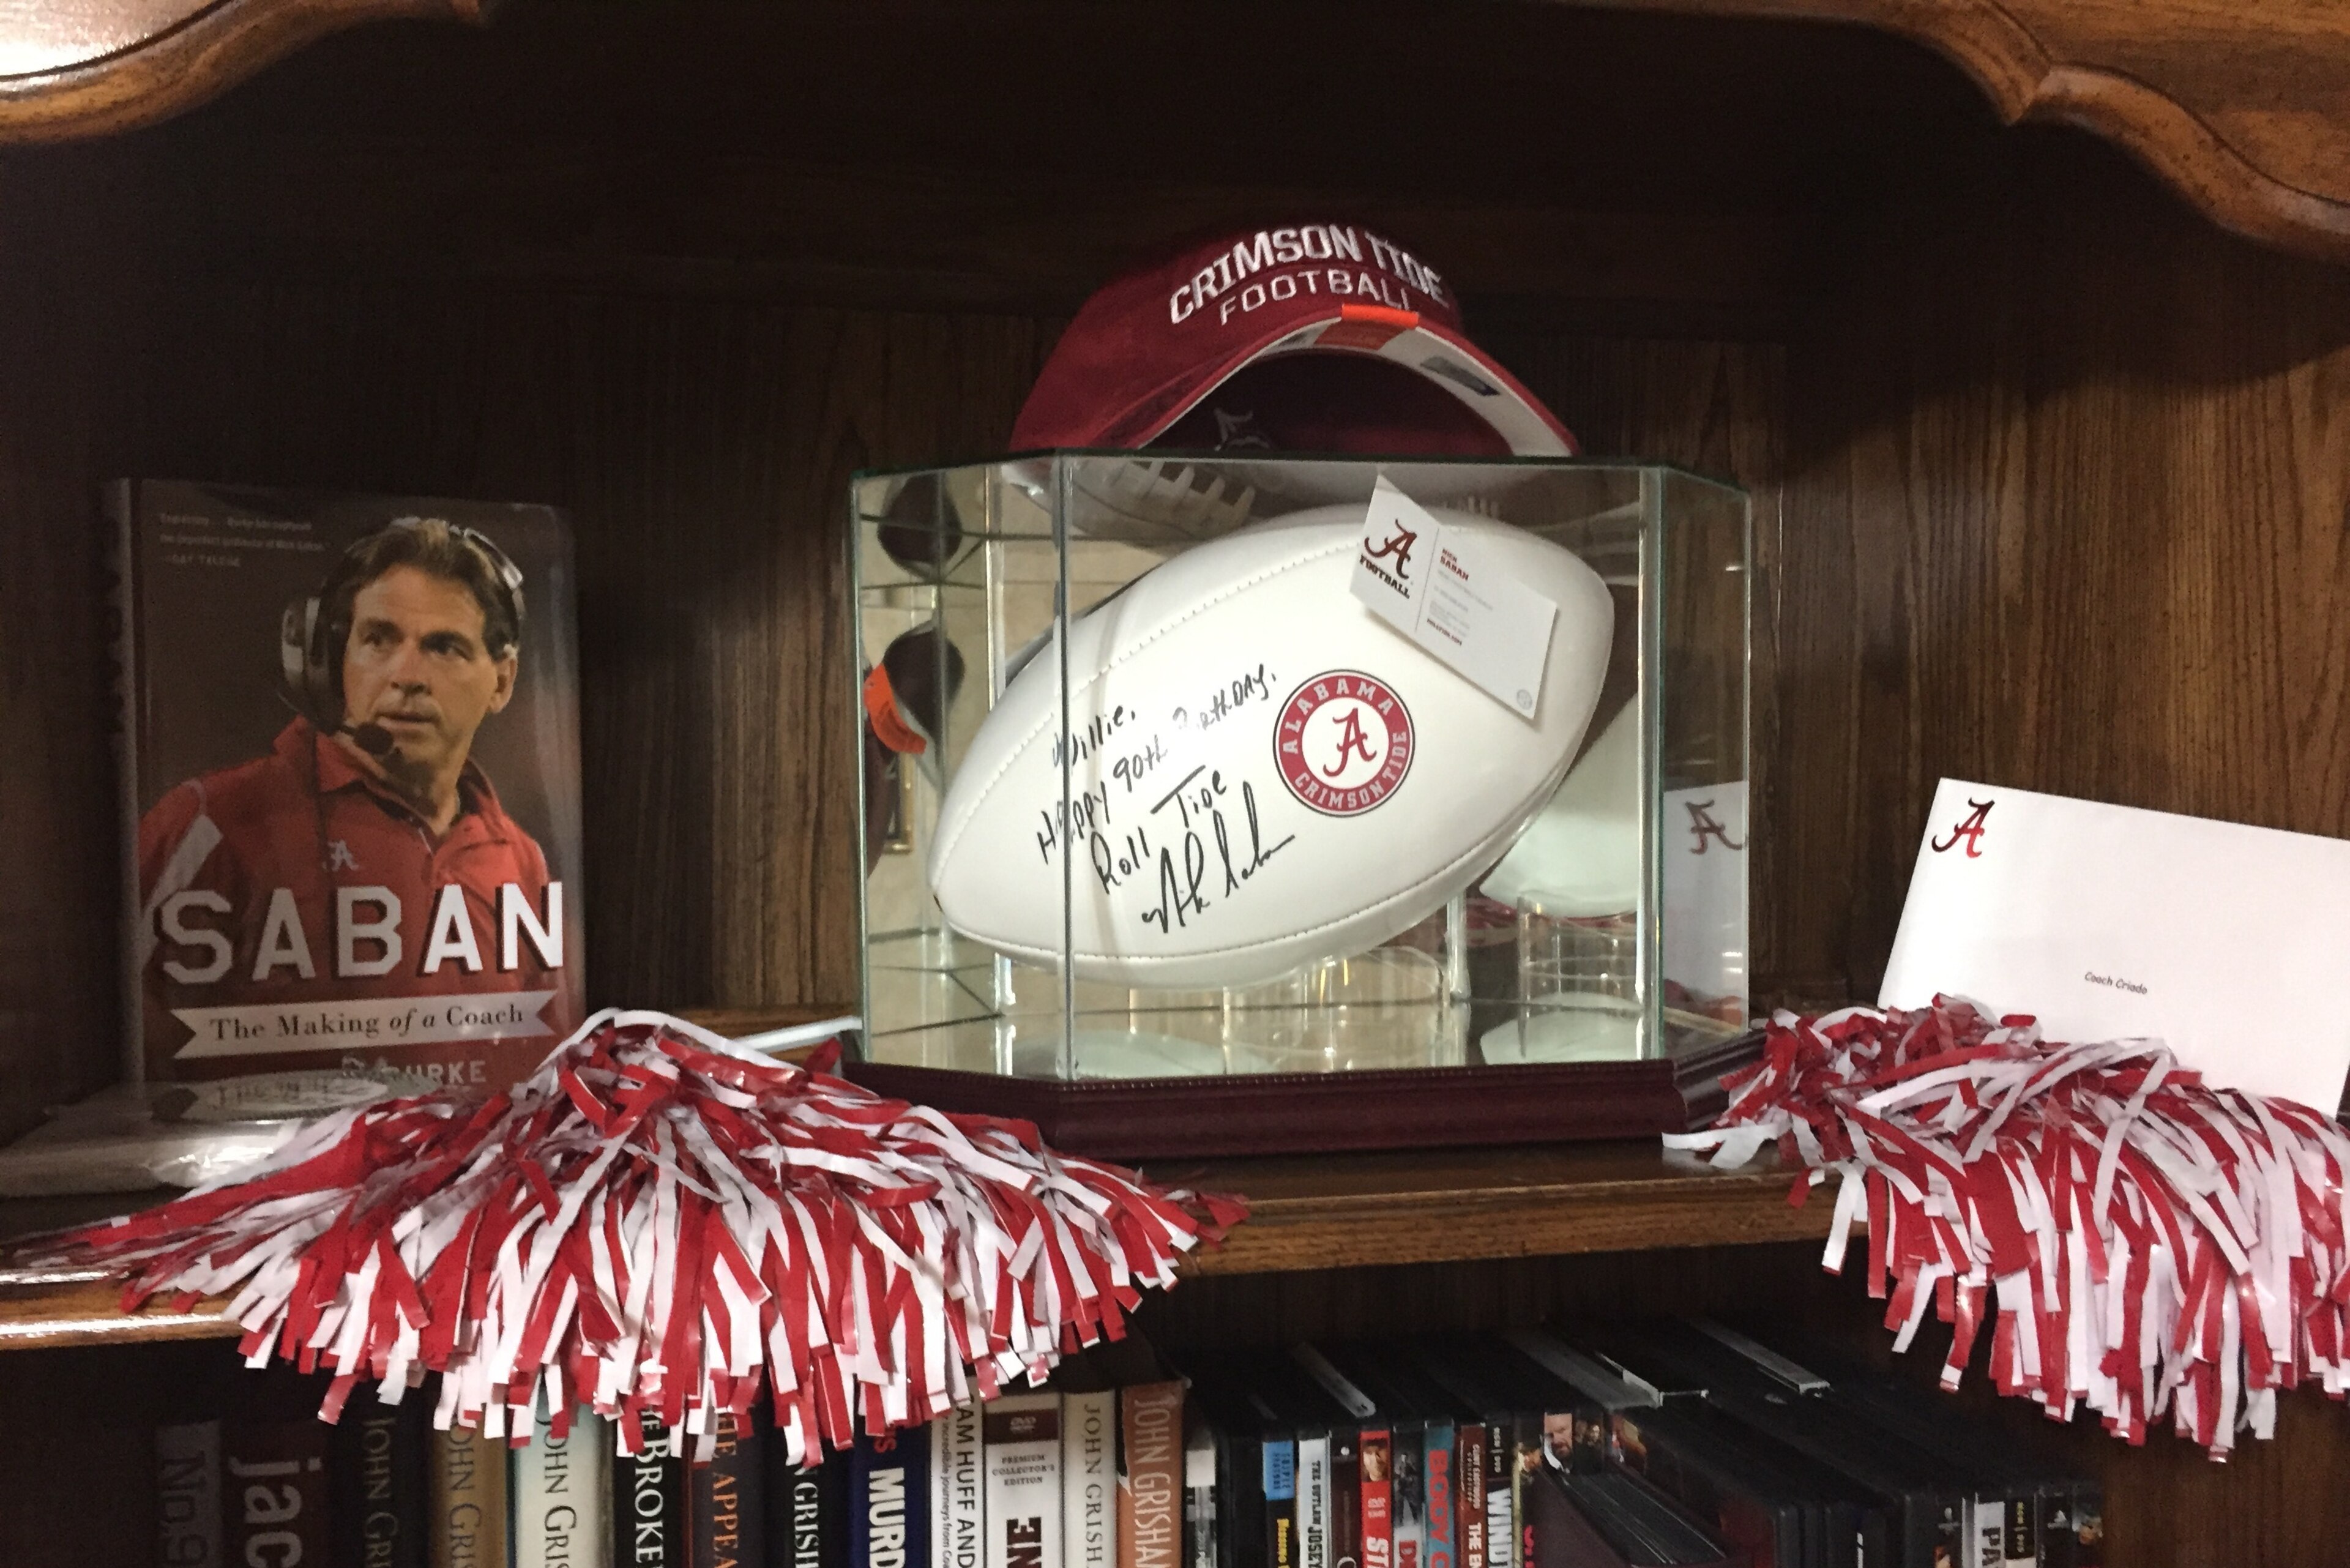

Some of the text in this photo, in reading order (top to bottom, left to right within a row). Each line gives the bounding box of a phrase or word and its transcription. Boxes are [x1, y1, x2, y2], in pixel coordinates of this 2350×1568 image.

[1169, 225, 1449, 325] CRIMSON TIDE
[1218, 268, 1411, 326] FOOTBALL
[1359, 554, 1410, 599] FOOTBALL
[1364, 518, 1417, 579] A
[1439, 555, 1469, 581] SABAN
[1282, 678, 1393, 755] ALABAMA
[1322, 707, 1378, 777] A
[1294, 731, 1407, 810] CRIMSON TIDE
[1931, 796, 1995, 859] A
[1090, 826, 1150, 894] Roll
[160, 881, 564, 984] SABAN
[2084, 971, 2147, 995] Coach Criado
[209, 1002, 524, 1042] The Making of a Coach
[362, 1417, 398, 1499] JOHN
[714, 1415, 737, 1458] HE
[942, 1423, 951, 1474] incredible
[1001, 1454, 1045, 1465] PREMIUM
[448, 1422, 482, 1568] OHN GRI
[635, 1405, 671, 1568] HE BROKE
[941, 1475, 951, 1521] journeys
[956, 1393, 976, 1568] AM HUFF AND
[991, 1463, 1055, 1476] COLLECTOR'S
[1004, 1477, 1043, 1487] EDITION
[1084, 1403, 1103, 1568] JOHN GRISH
[1134, 1397, 1173, 1568] JOHN GRISHA
[1311, 1460, 1321, 1481] THE
[1429, 1449, 1450, 1544] BODY
[228, 1455, 323, 1568] jac
[868, 1467, 906, 1568] MURD
[1311, 1484, 1322, 1525] OUTLAW
[942, 1523, 952, 1548] from
[1367, 1536, 1389, 1568] ST
[1468, 1522, 1482, 1550] THE
[1982, 1527, 2001, 1568] PA
